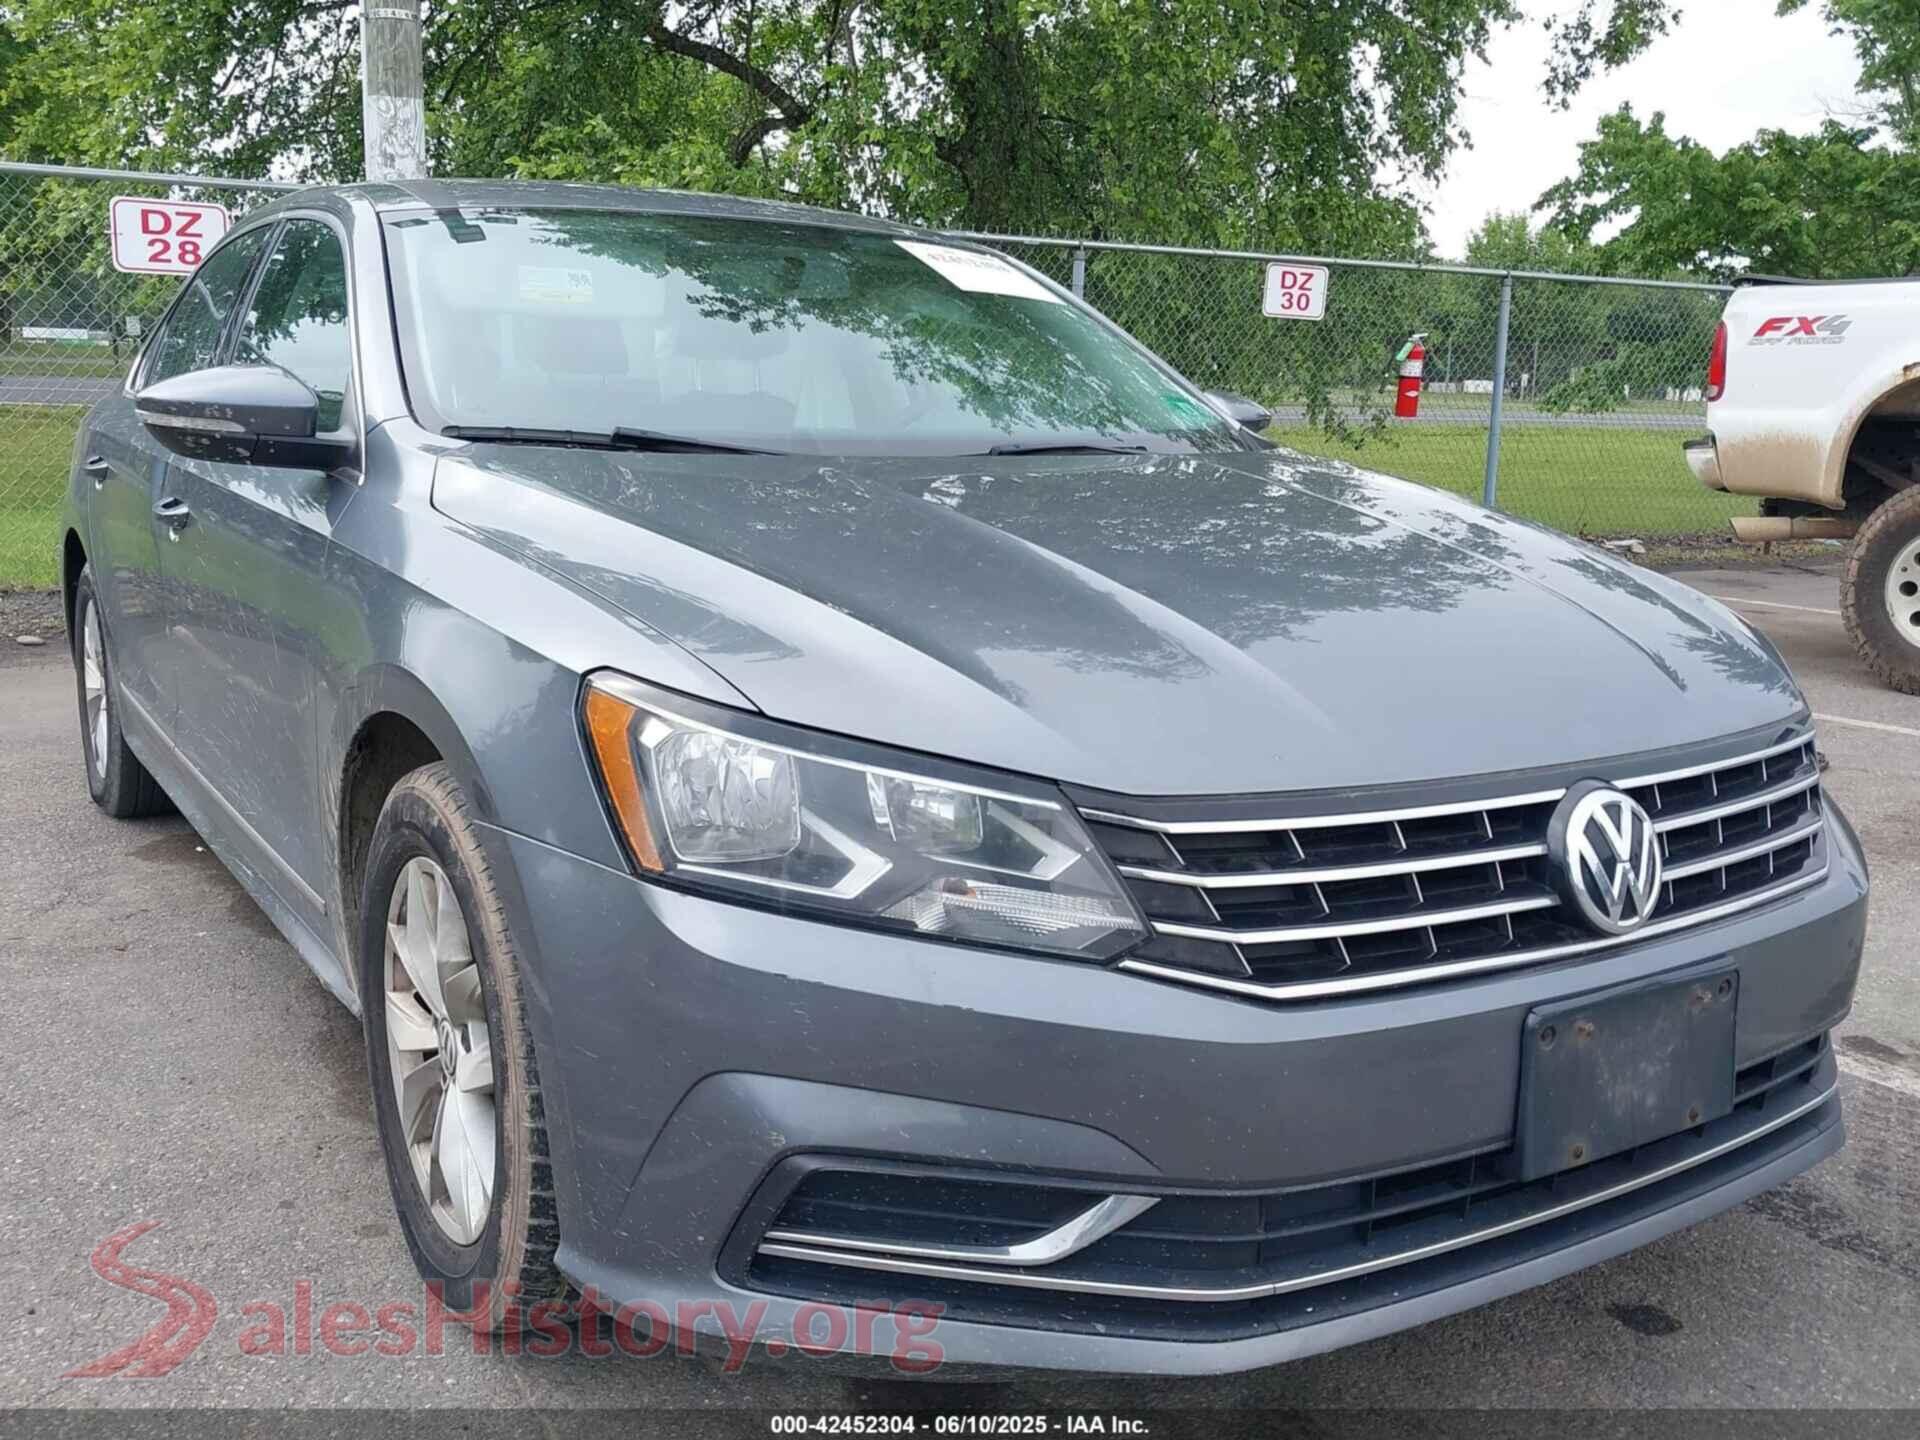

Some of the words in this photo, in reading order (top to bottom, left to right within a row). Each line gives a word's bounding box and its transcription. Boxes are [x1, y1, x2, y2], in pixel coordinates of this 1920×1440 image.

[141, 208, 203, 238] DZ
[147, 238, 202, 266] 28
[1281, 270, 1314, 291] DZ
[1281, 291, 1310, 311] 30
[1753, 315, 1852, 336] FX4
